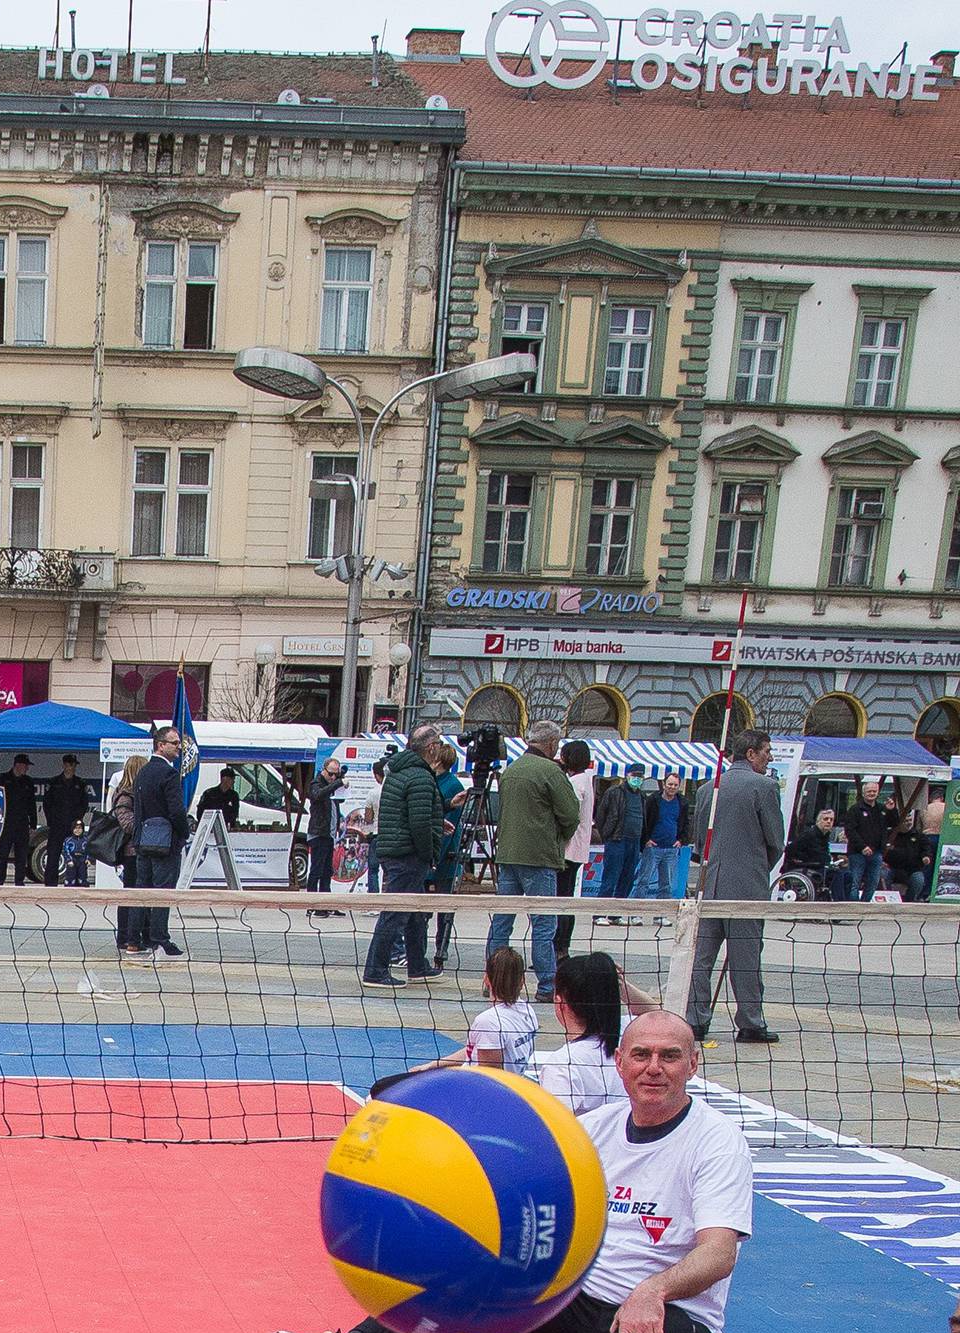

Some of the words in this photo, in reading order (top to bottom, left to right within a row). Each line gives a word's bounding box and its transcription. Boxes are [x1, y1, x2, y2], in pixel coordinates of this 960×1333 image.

[635, 8, 851, 54] CROATIA
[38, 47, 187, 85] HOTEL
[631, 52, 943, 102] OSIGURANJE
[446, 587, 551, 610] GRADSKI
[599, 592, 662, 613] RADIO
[506, 639, 540, 652] HPB
[553, 639, 583, 653] Moja
[586, 640, 626, 654] banka.
[739, 646, 818, 661] HRVATSKA
[822, 645, 918, 665] POŠTANSKA
[614, 1186, 632, 1200] ZA
[631, 1202, 658, 1216] BEZ
[537, 1204, 556, 1260] FIVB
